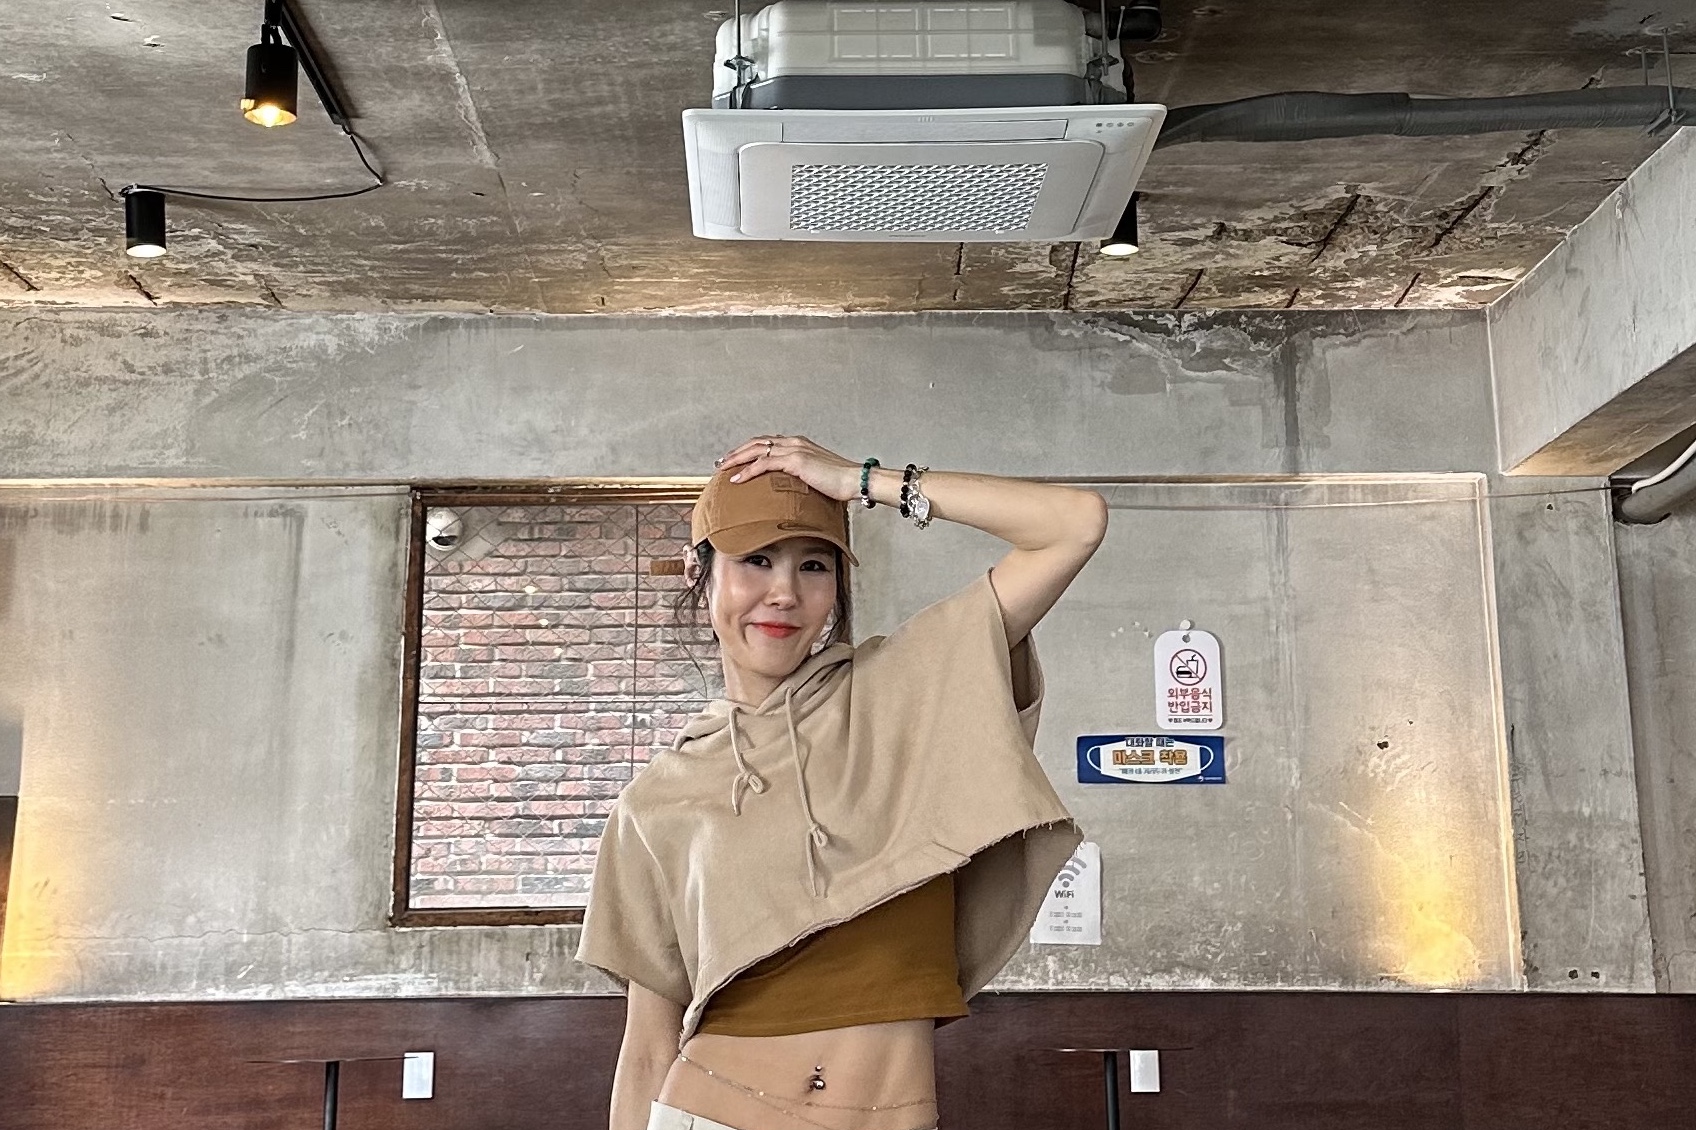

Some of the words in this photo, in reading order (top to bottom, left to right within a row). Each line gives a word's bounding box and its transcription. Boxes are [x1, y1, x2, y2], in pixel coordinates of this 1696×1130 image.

[1167, 687, 1212, 700] 외부음식
[1168, 701, 1213, 713] 반입금지
[1112, 750, 1155, 765] 마스크
[1159, 749, 1188, 765] 착용
